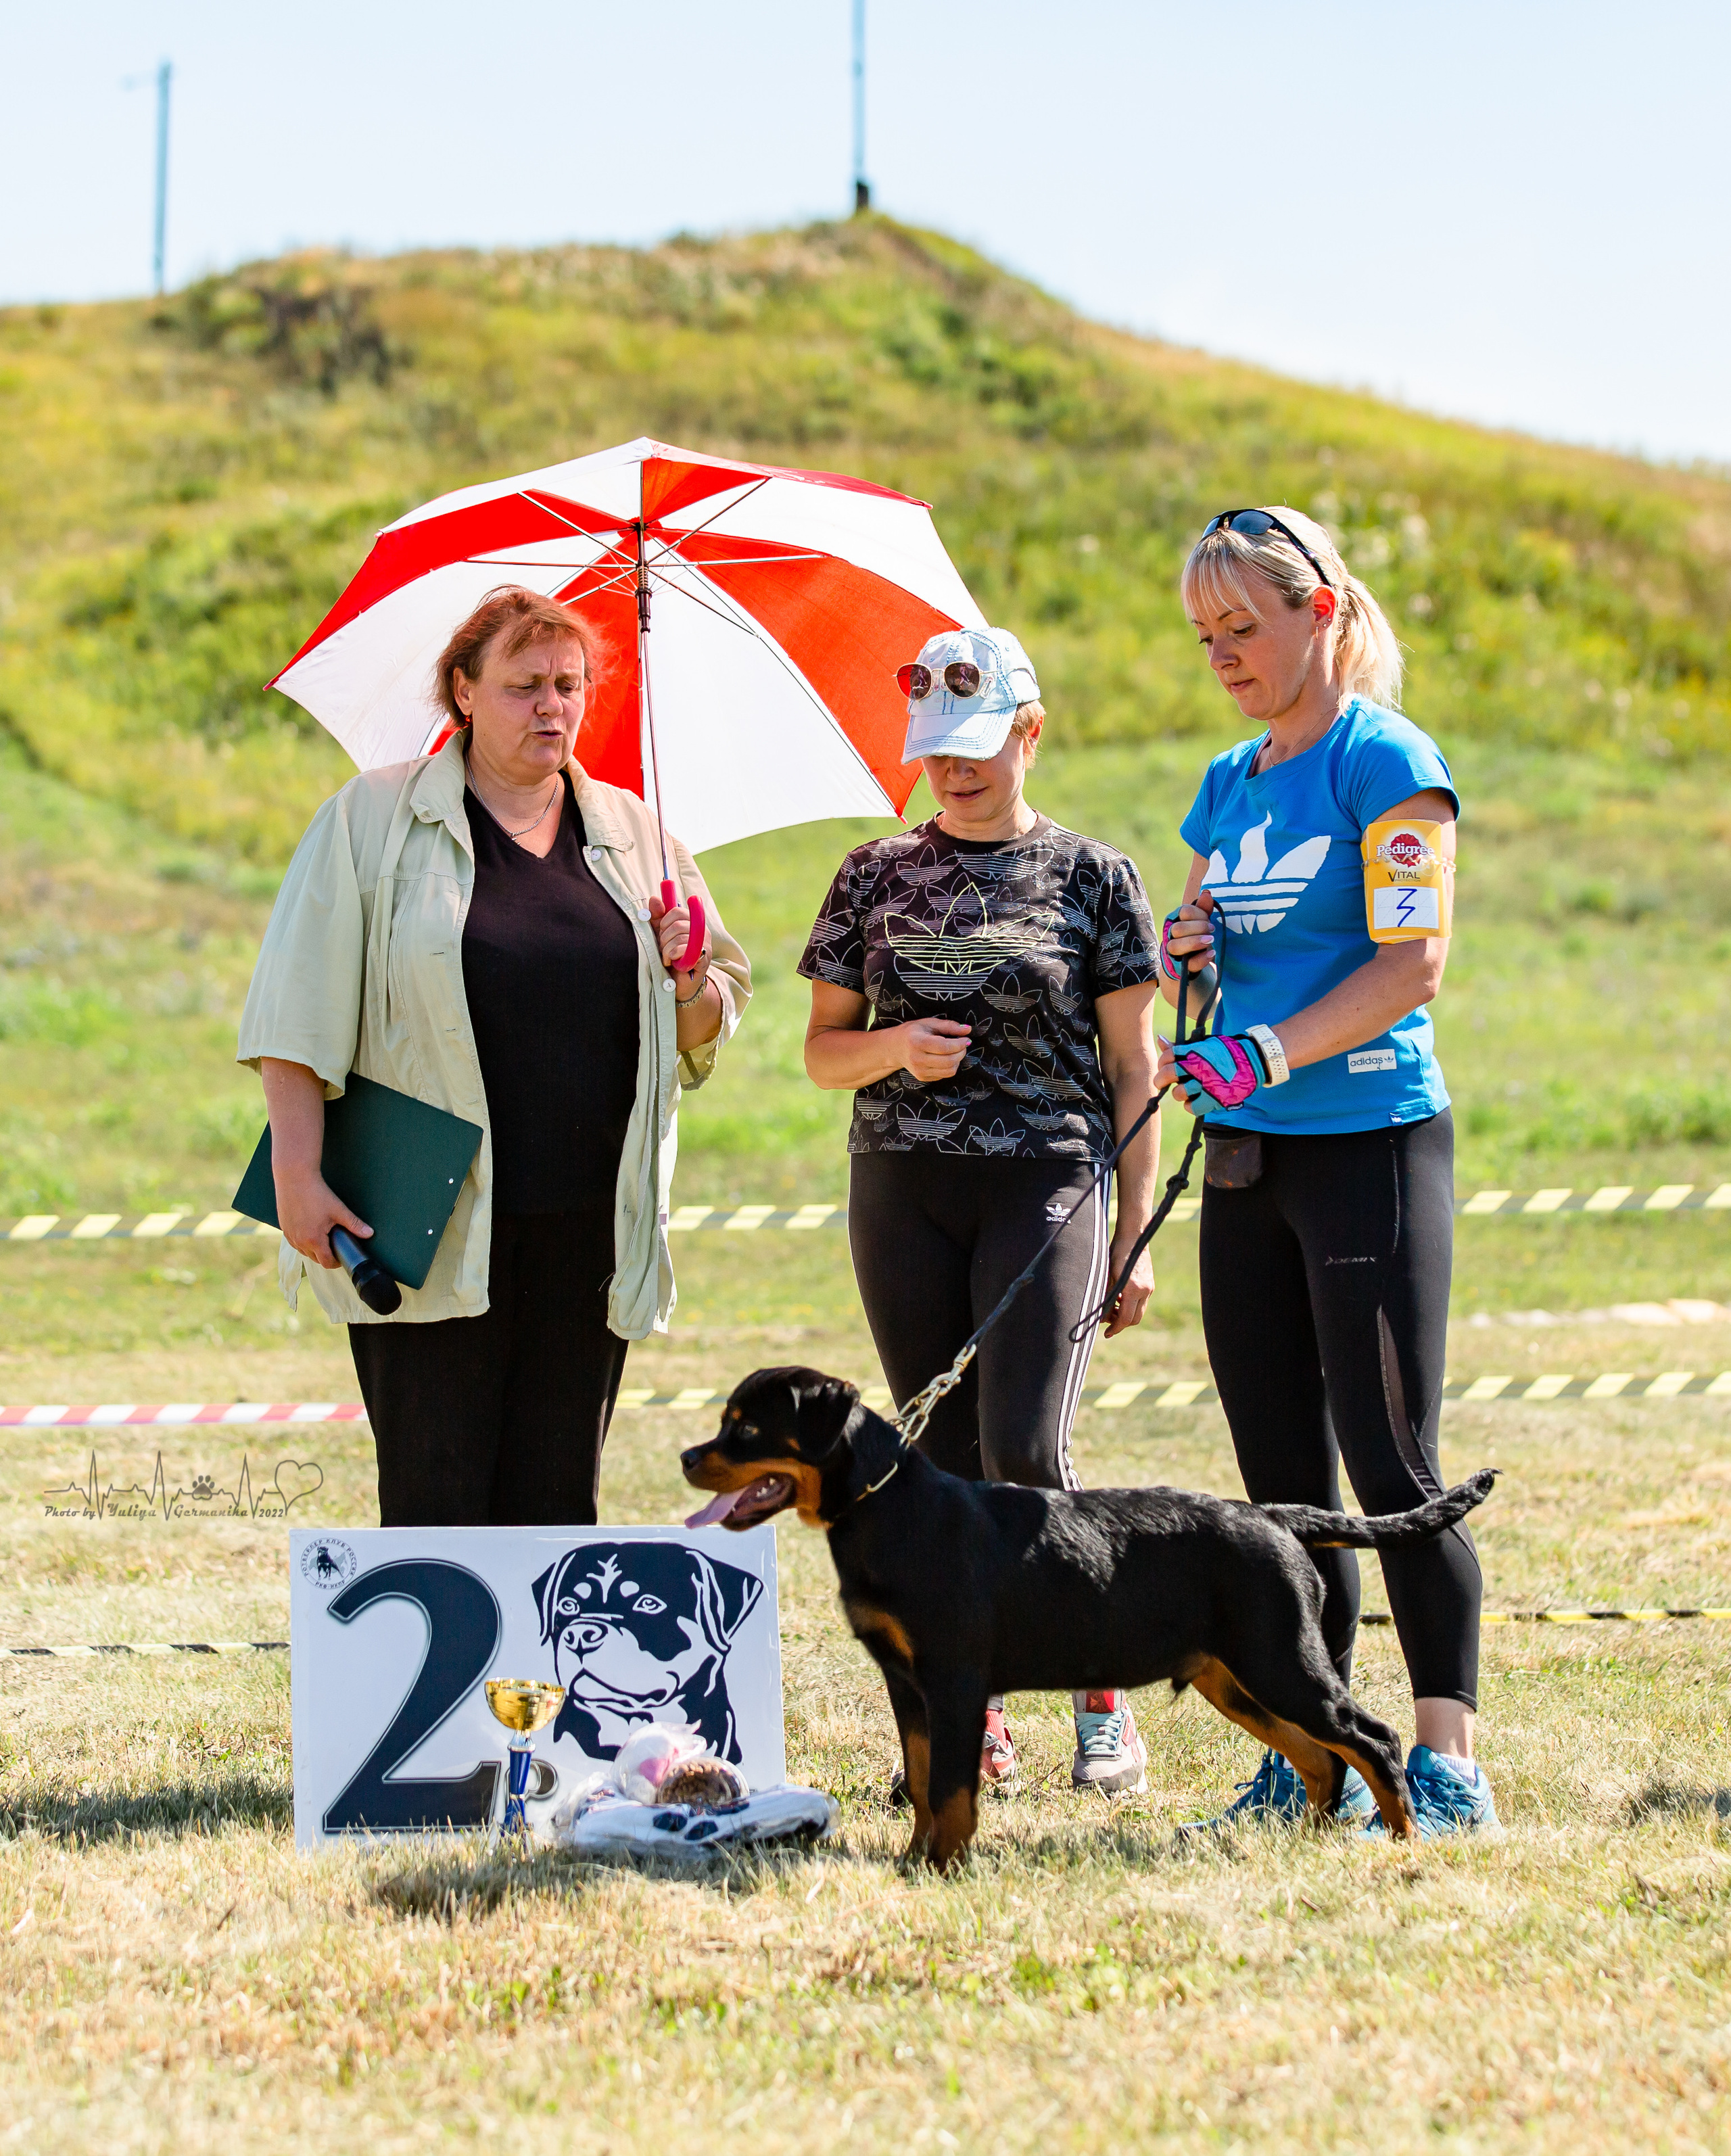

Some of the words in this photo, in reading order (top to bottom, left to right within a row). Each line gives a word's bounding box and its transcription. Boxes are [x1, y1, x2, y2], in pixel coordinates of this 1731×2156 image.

[1376, 843, 1435, 857] Pedigree
[1388, 869, 1421, 882] VITAL
[1396, 888, 1417, 928] 3
[1350, 1056, 1383, 1067] adidas
